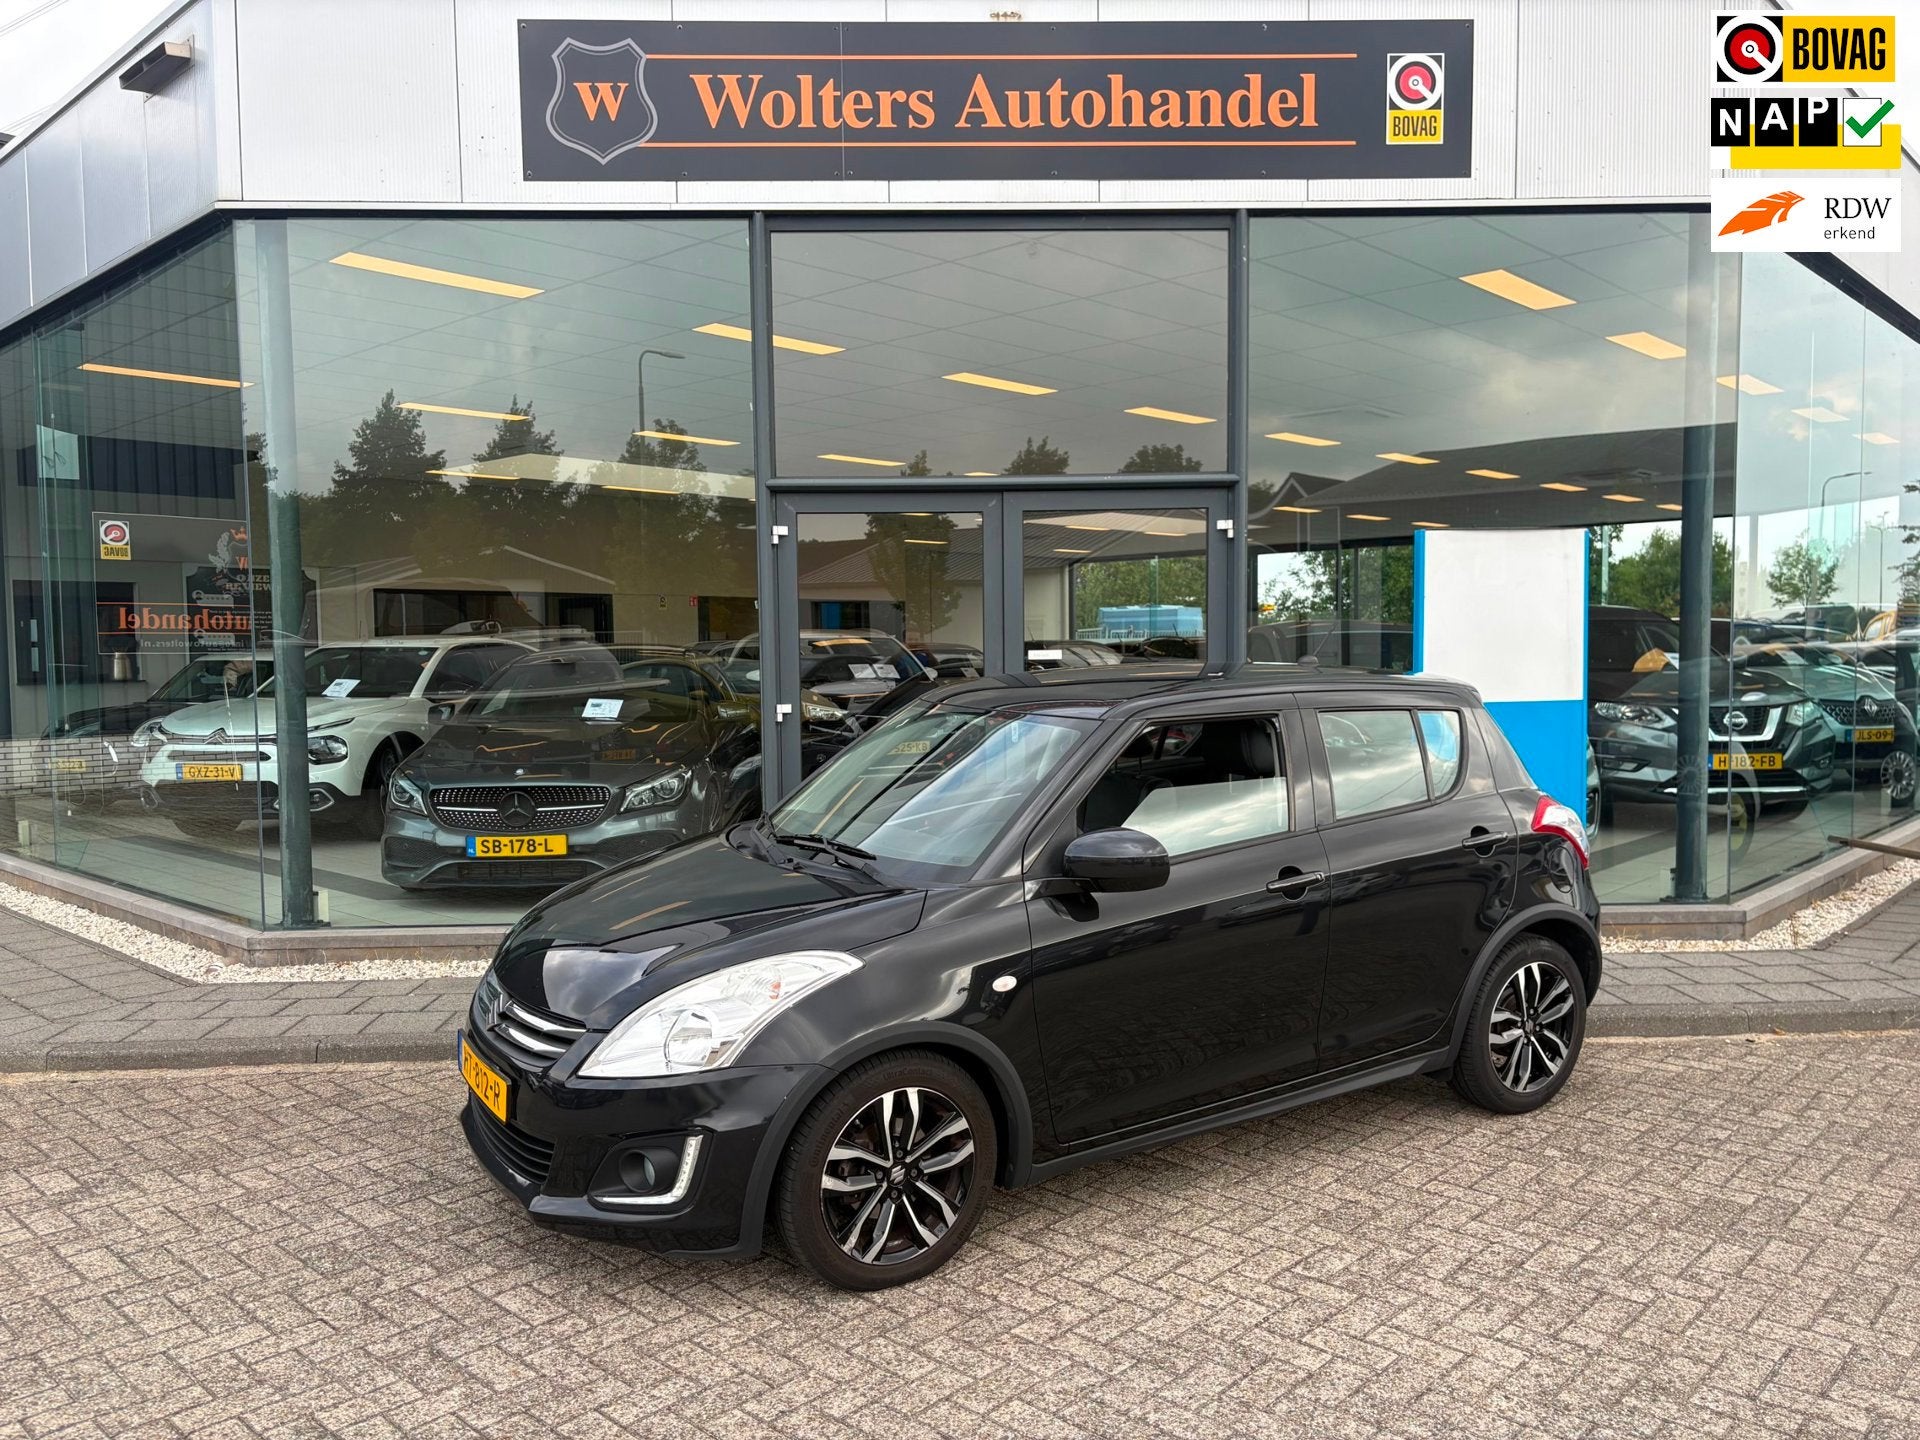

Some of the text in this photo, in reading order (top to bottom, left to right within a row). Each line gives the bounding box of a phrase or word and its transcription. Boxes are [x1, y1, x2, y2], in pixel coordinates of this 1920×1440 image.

[573, 82, 629, 121] W
[689, 73, 1319, 129] Wolters Autohandel
[1392, 115, 1437, 138] BOVAG
[189, 766, 235, 778] GXZ-31-V
[480, 838, 554, 854] SB-178-L
